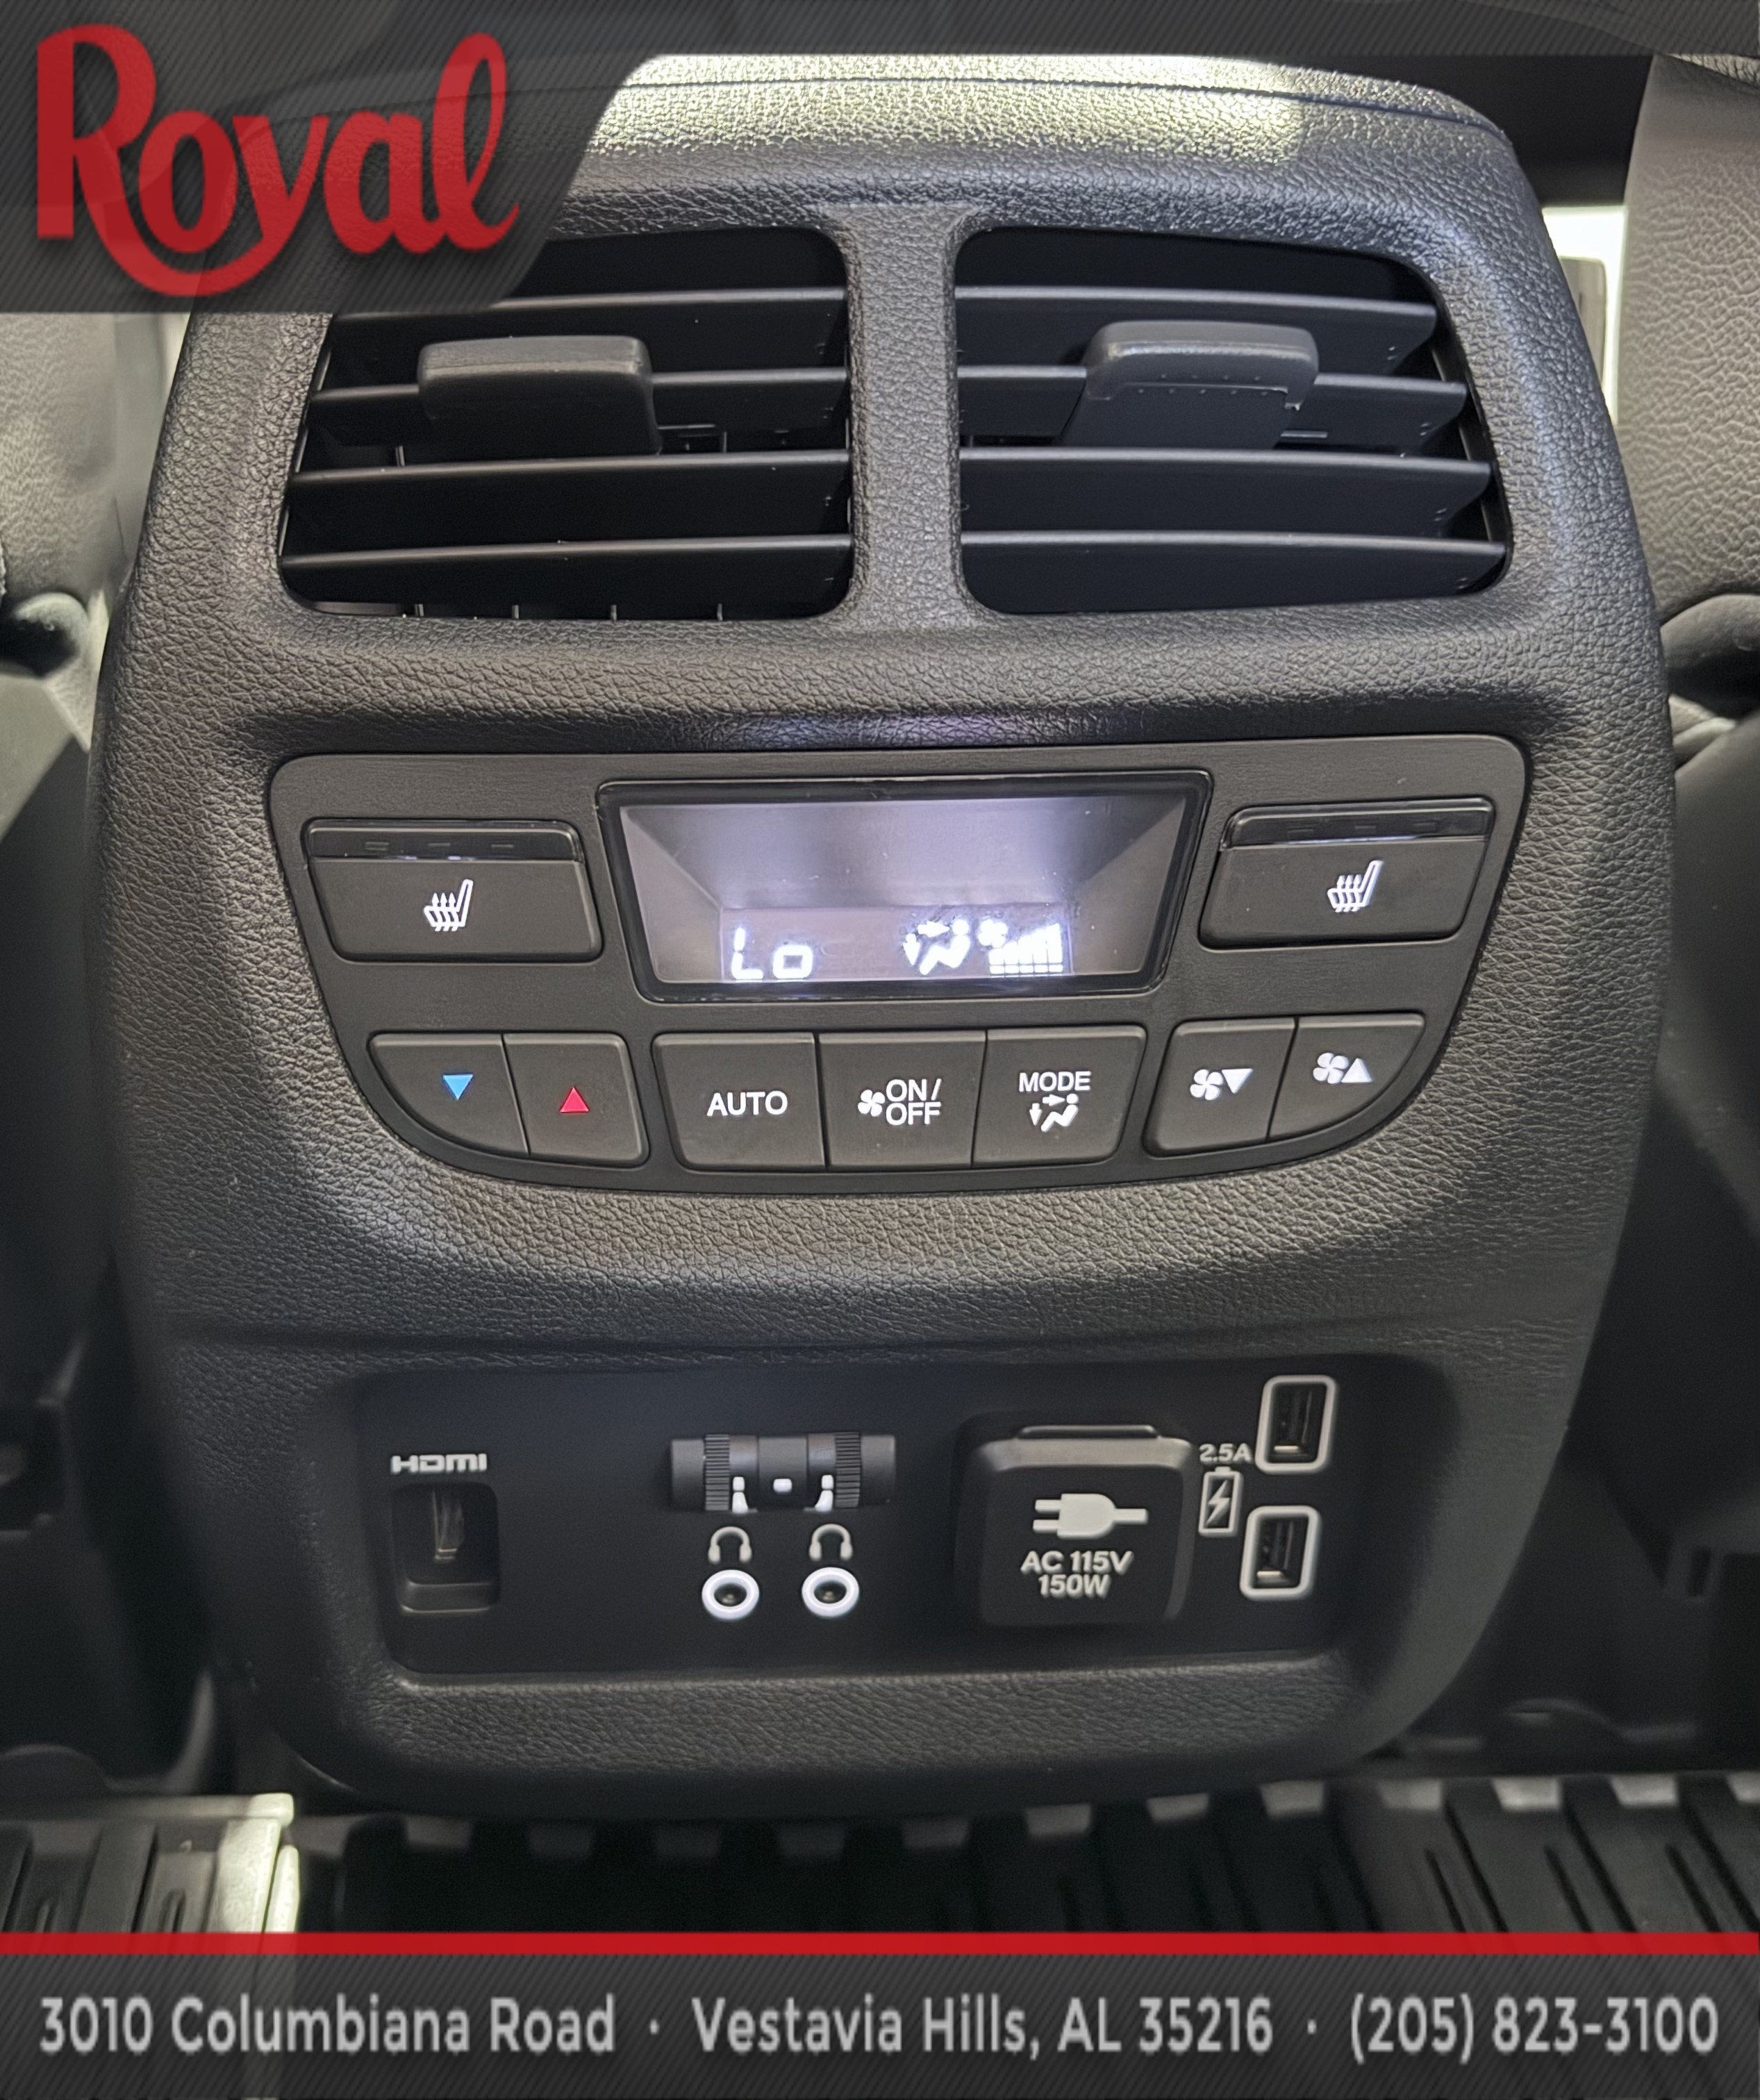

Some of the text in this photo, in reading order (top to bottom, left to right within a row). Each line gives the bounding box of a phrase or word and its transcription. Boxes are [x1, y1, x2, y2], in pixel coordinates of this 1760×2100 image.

[886, 1078, 942, 1101] ON/
[1019, 1071, 1091, 1092] MODE
[707, 1091, 788, 1117] AUTO
[886, 1103, 941, 1126] OFF
[391, 1453, 487, 1473] HDMI
[1199, 1443, 1252, 1463] 2.5A
[1021, 1551, 1132, 1572] AC 115V
[1039, 1574, 1109, 1597] 150W
